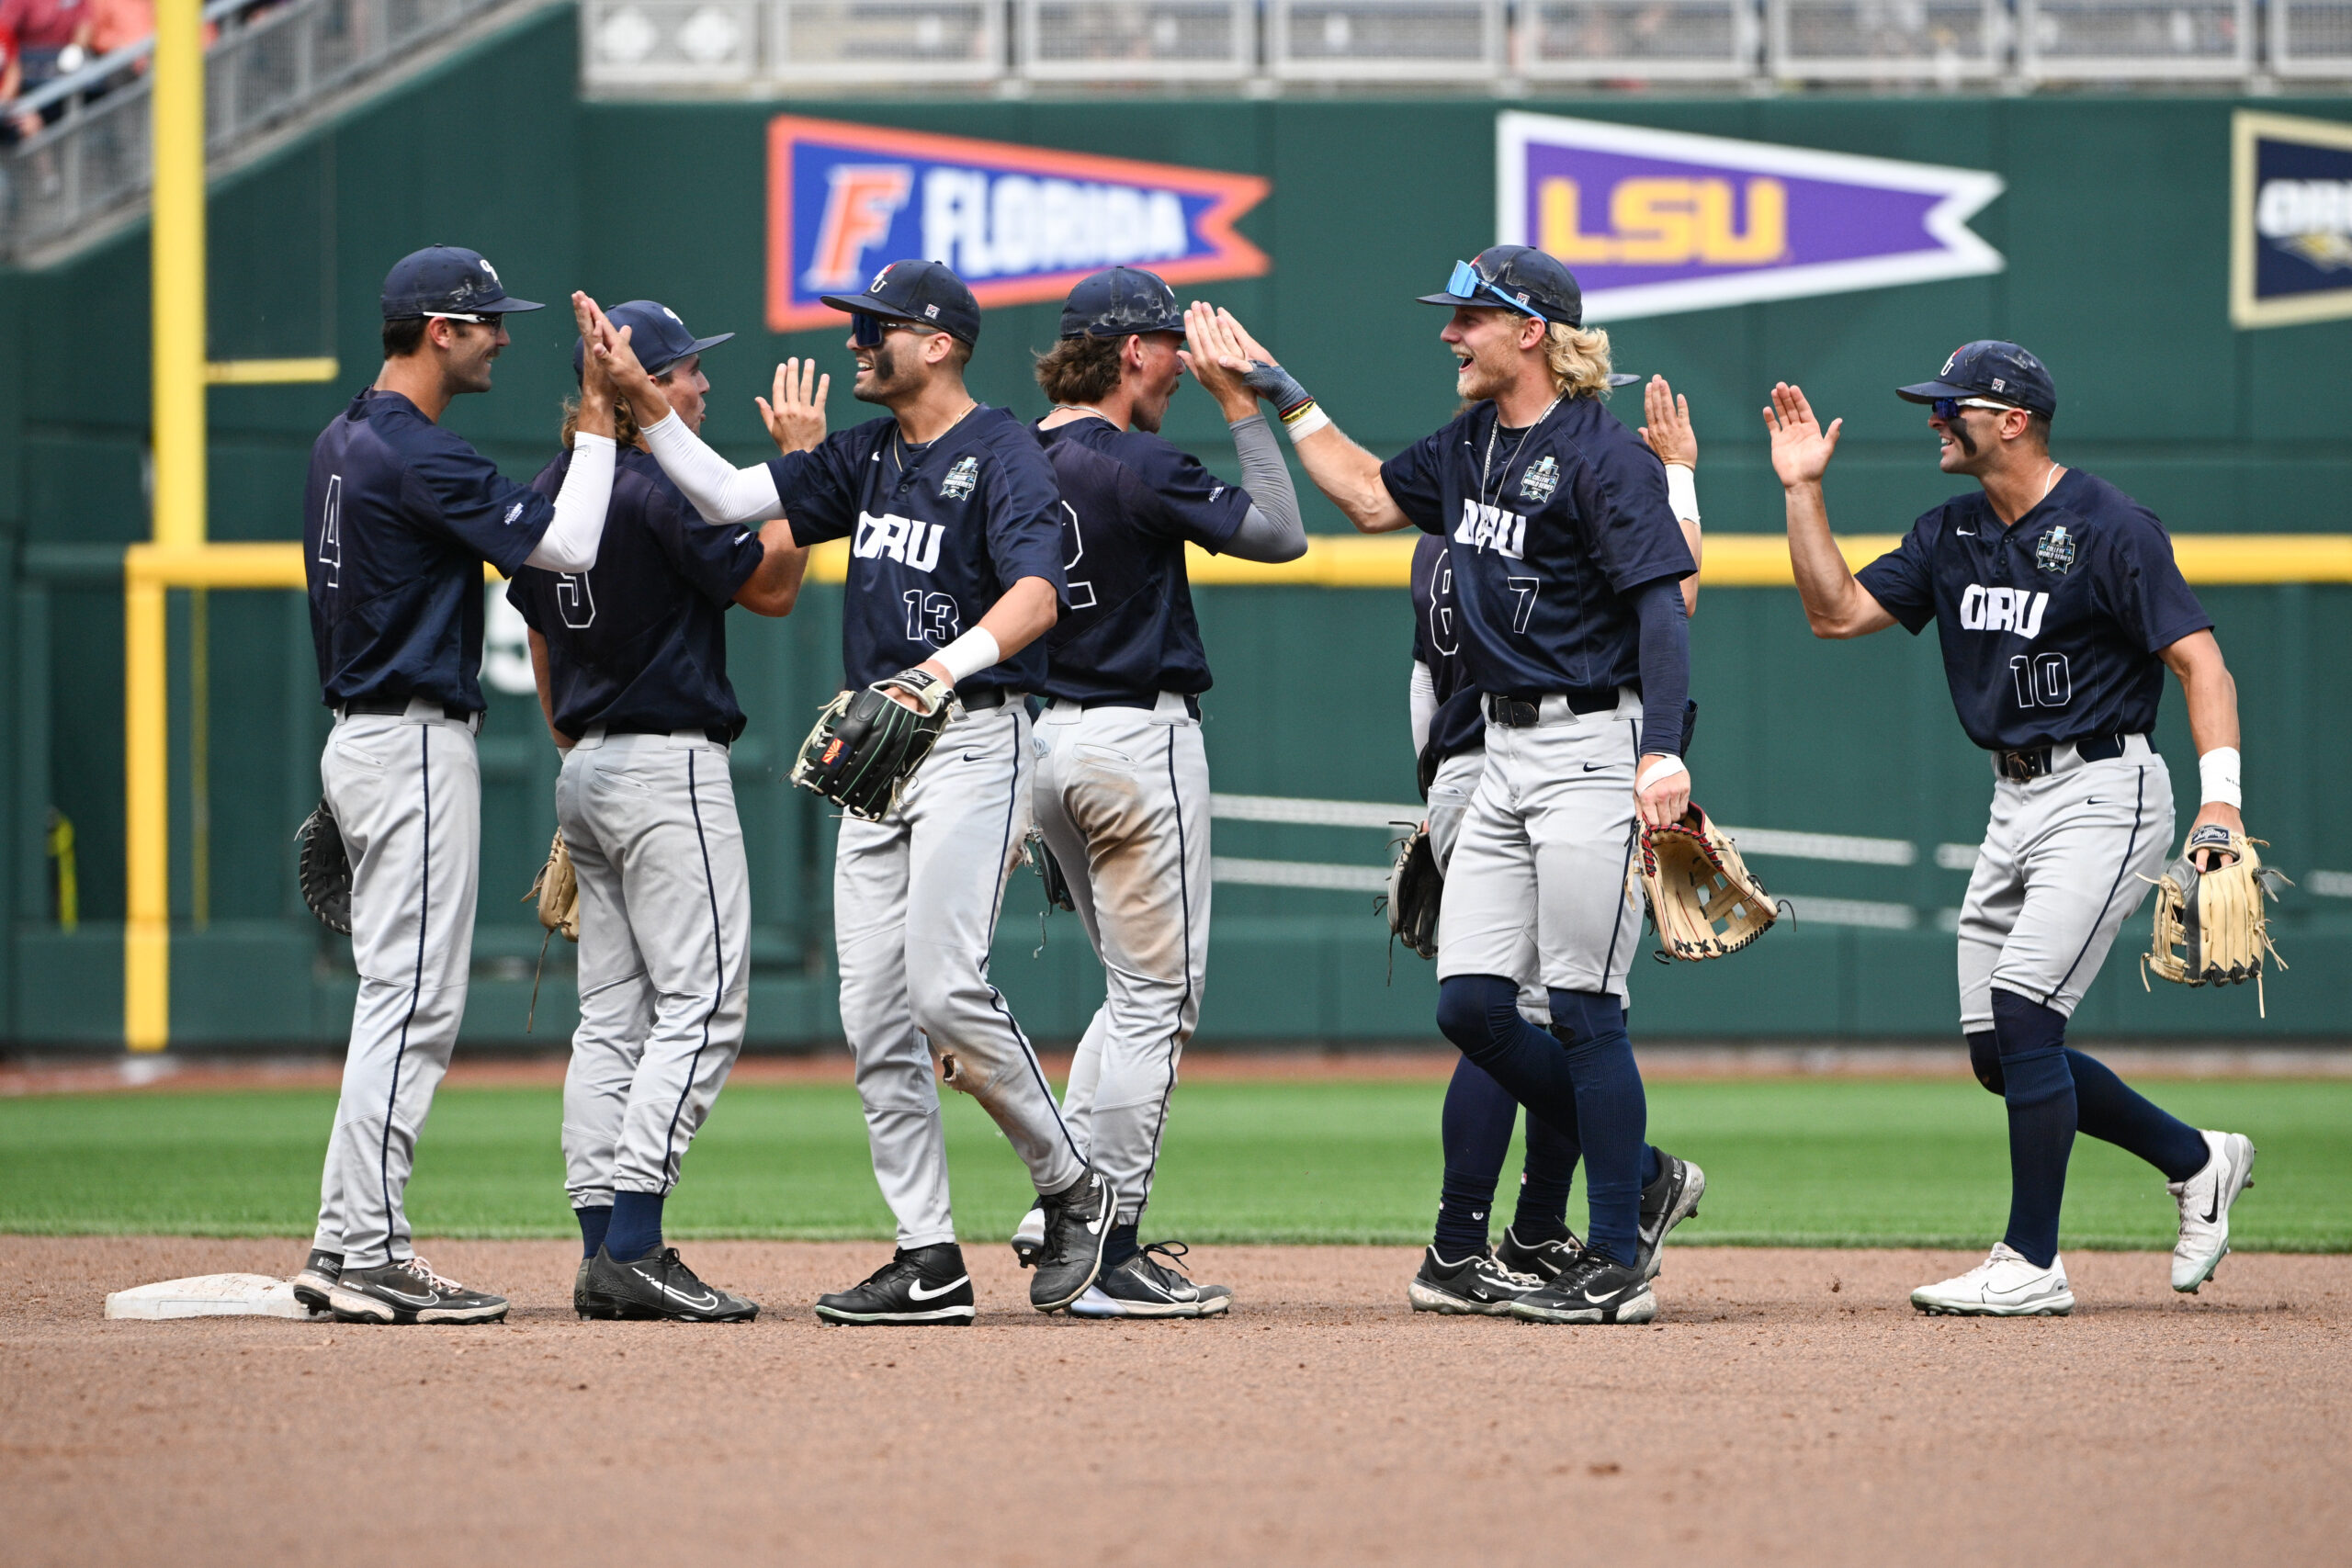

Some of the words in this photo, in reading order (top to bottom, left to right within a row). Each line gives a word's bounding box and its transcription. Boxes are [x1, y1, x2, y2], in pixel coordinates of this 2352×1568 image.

[805, 164, 914, 291] F
[922, 165, 1189, 276] FLORIDA
[1539, 177, 1786, 264] LSU
[319, 473, 341, 588] 4
[853, 511, 945, 573] ORU
[1453, 498, 1527, 560] ORU
[903, 589, 960, 650] 13
[1508, 576, 1540, 634] 7
[1960, 583, 2050, 639] ORU
[2009, 652, 2071, 708] 10
